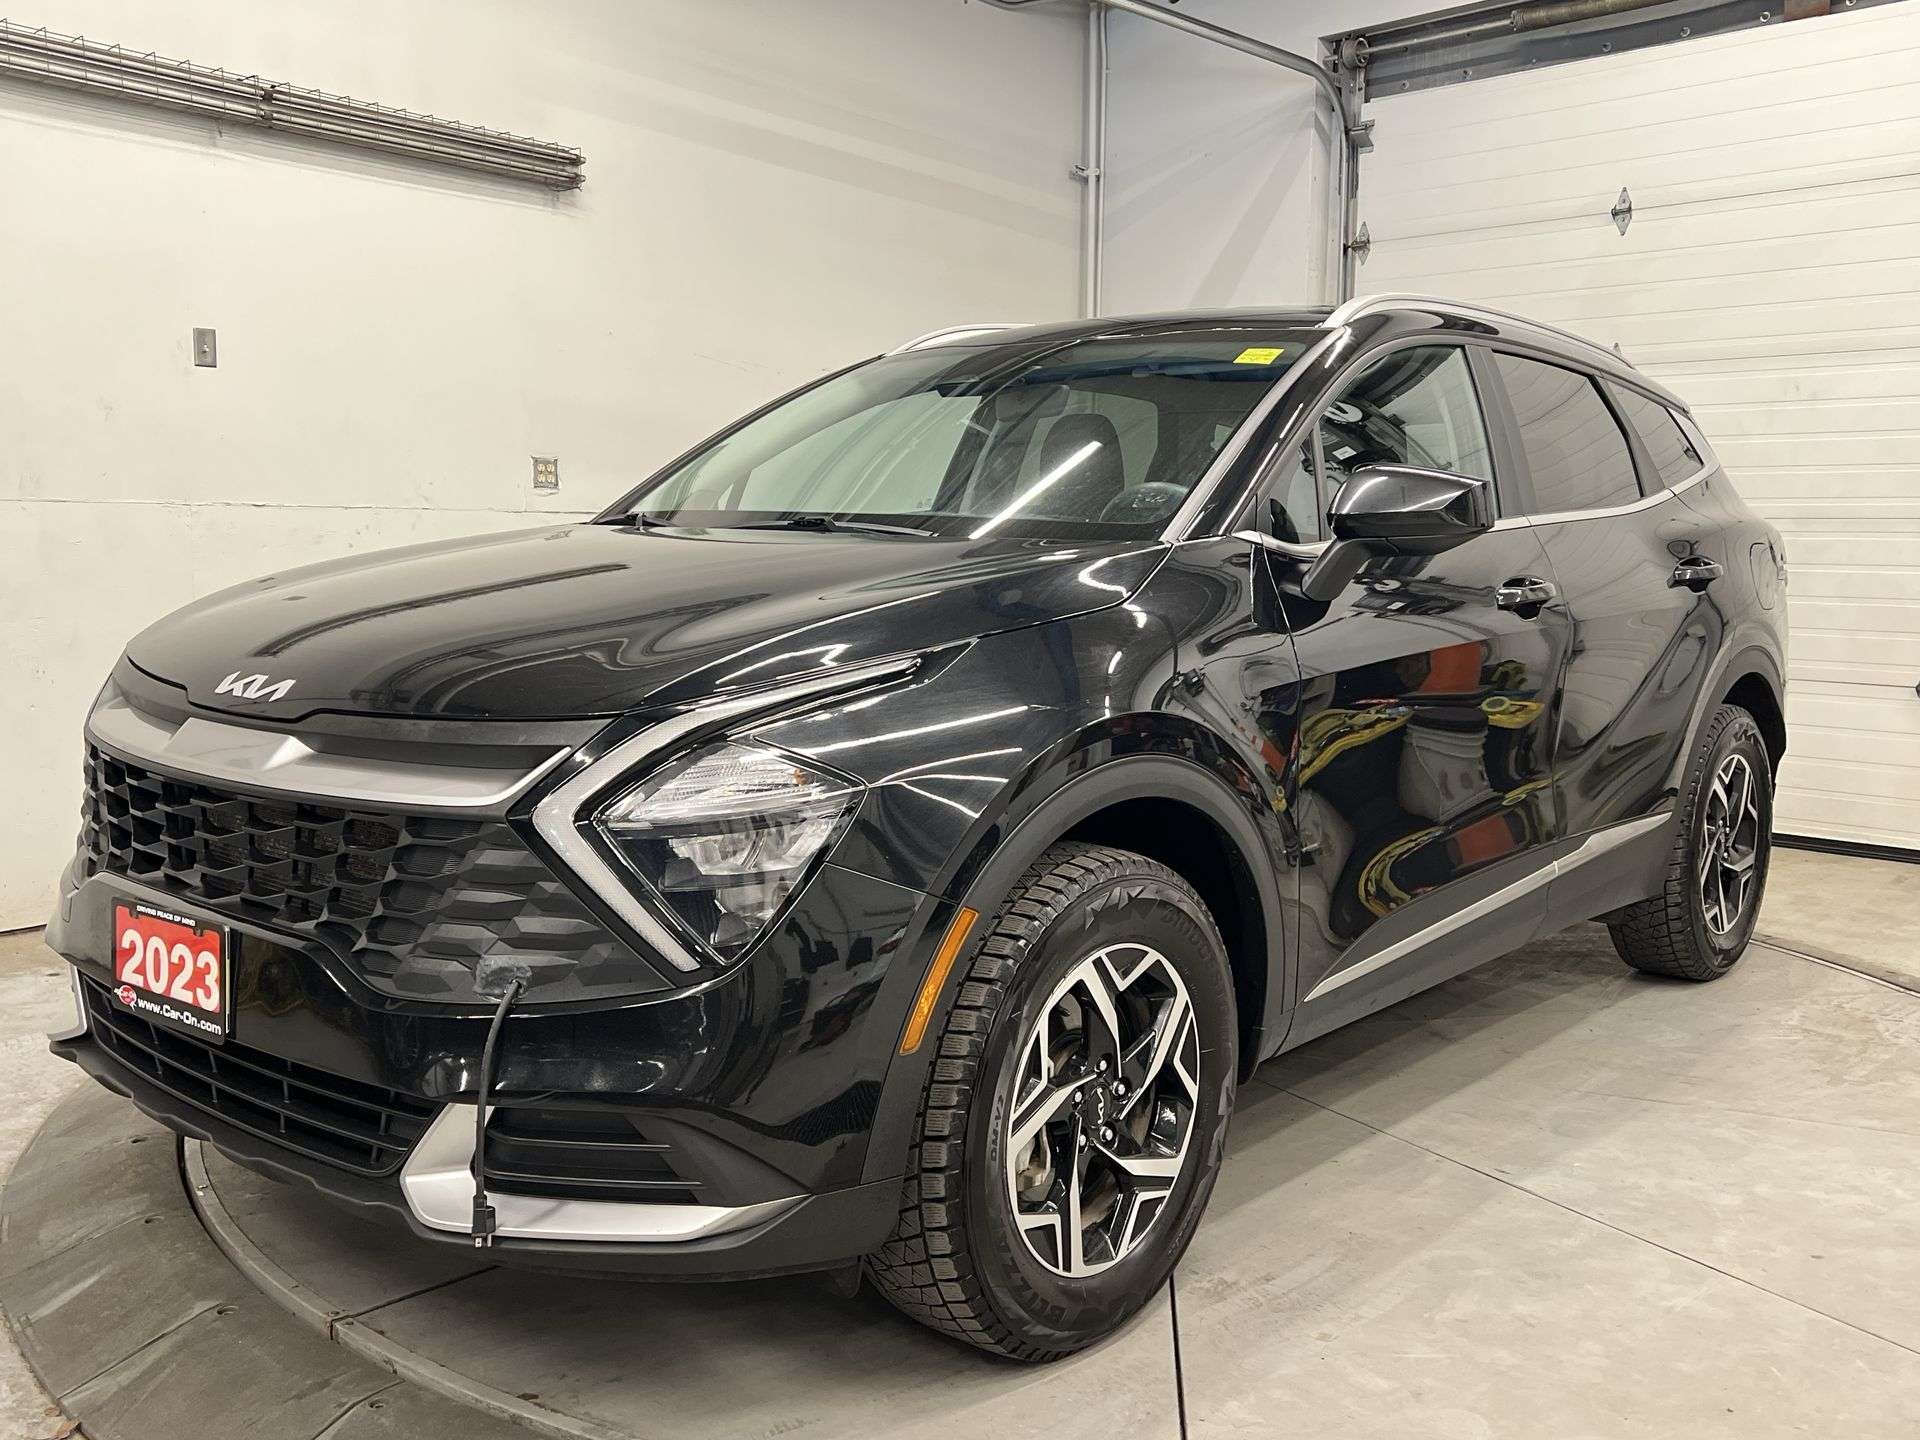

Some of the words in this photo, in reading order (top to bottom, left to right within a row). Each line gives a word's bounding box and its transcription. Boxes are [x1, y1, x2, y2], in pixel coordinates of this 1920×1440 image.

[214, 670, 297, 702] KIA
[121, 929, 219, 1011] 2023
[137, 998, 222, 1036] www.Car-On.com
